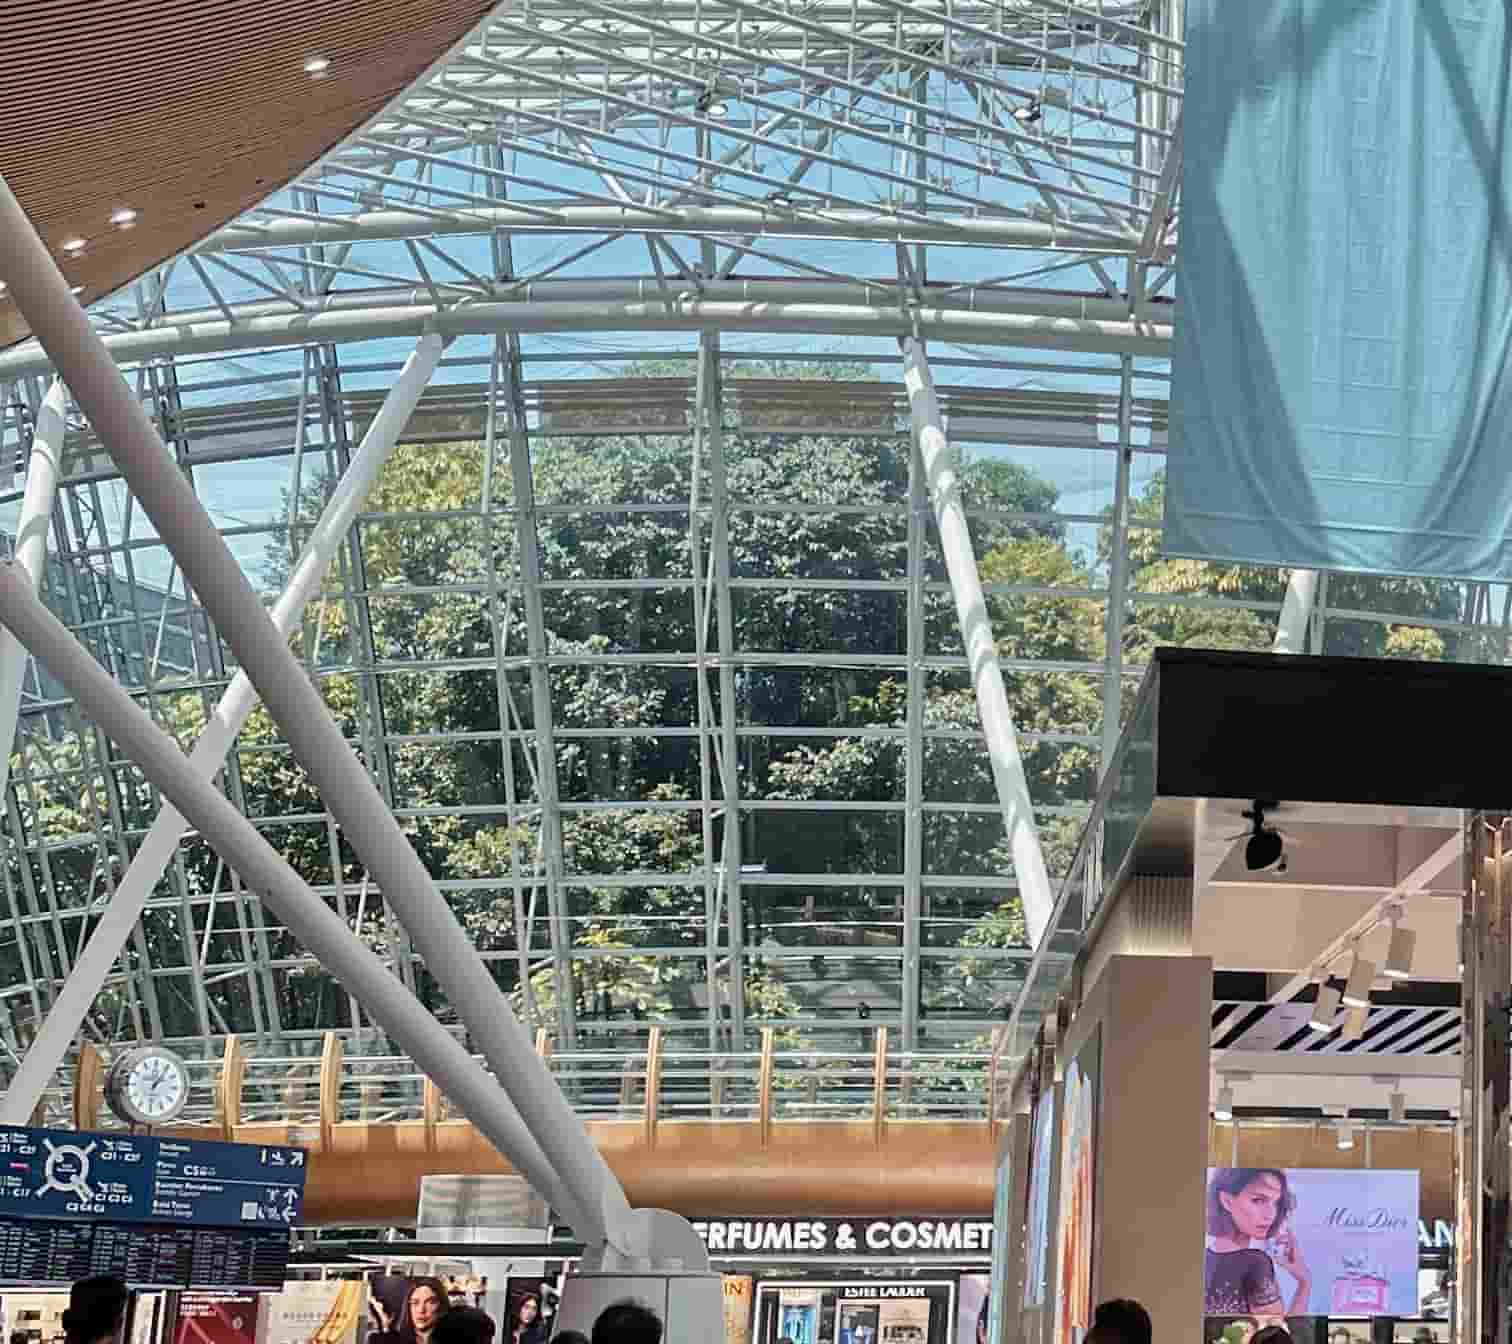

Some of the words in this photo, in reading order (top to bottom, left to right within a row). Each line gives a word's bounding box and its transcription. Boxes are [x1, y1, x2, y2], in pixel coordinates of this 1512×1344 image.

[1321, 1207, 1366, 1227] Miss
[1367, 1207, 1409, 1230] Dior
[835, 1222, 857, 1249] &
[865, 1222, 993, 1249] COSMET
